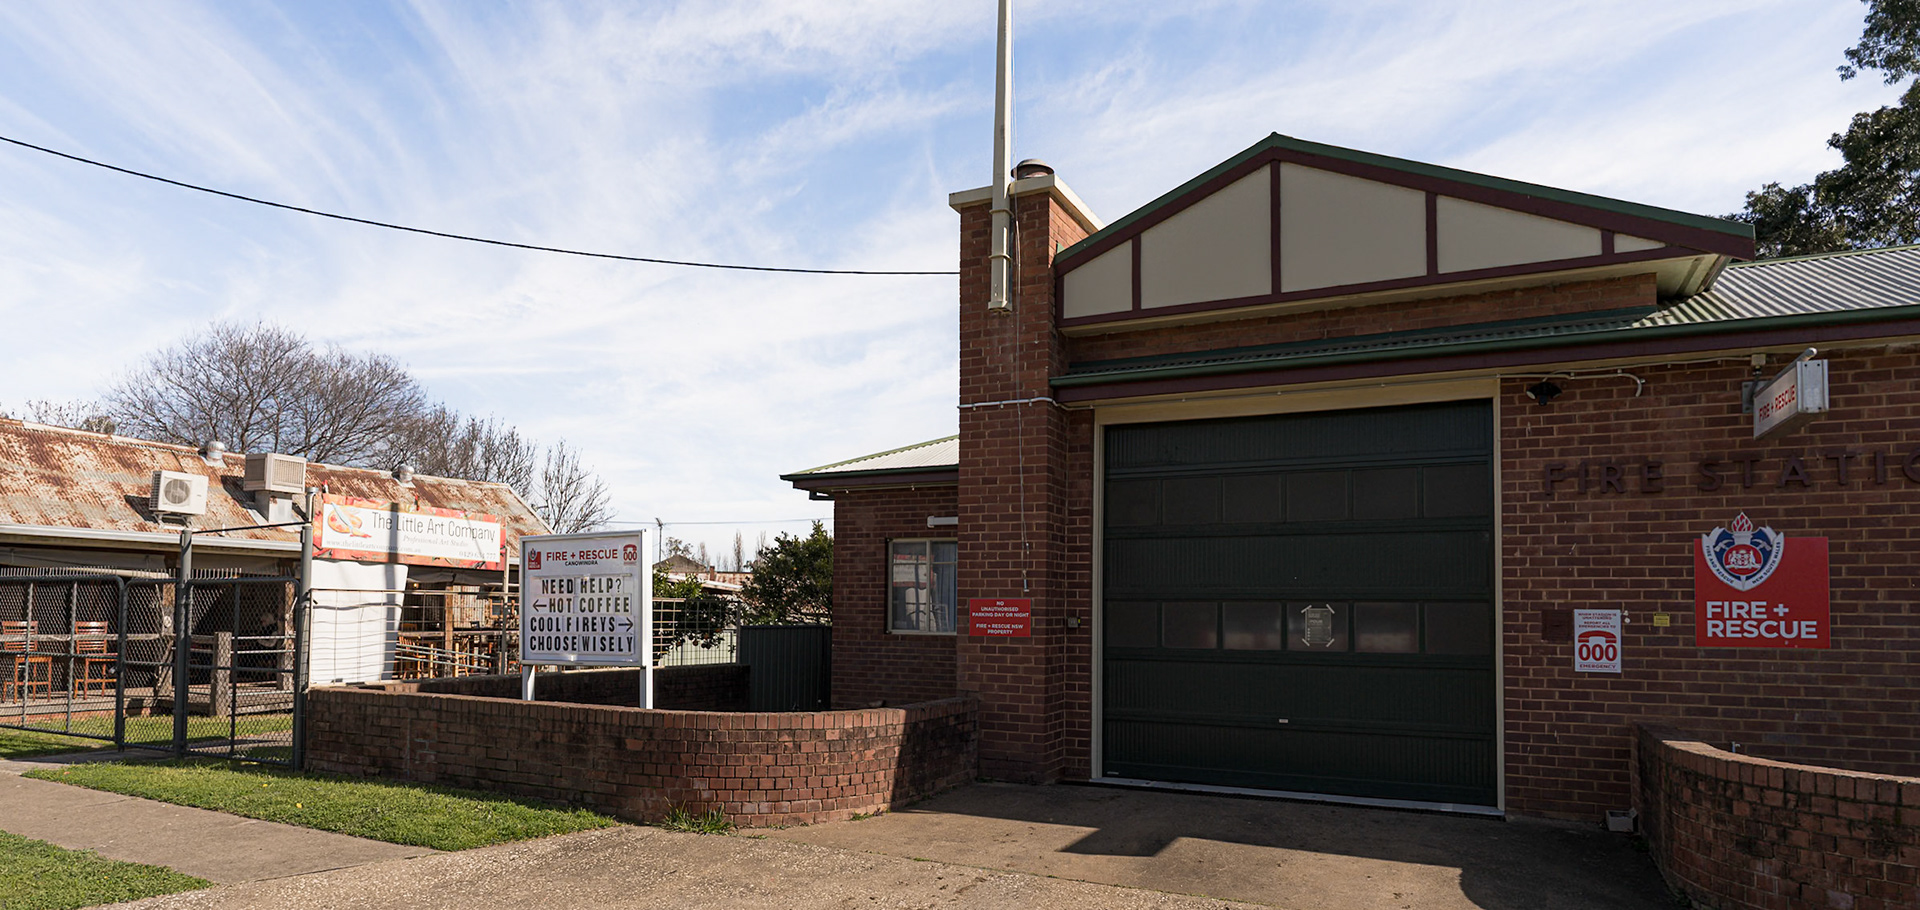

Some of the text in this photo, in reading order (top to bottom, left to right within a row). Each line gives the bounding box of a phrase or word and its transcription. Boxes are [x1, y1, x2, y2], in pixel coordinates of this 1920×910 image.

[1759, 403, 1770, 422] FIRE
[1775, 384, 1795, 412] RESCUE
[1544, 460, 1665, 496] FIRE
[372, 511, 496, 543] The Little Art Company
[403, 534, 469, 548] Professional Art Studio
[546, 551, 568, 562] FIRE
[579, 549, 618, 560] RESCUE
[623, 551, 637, 561] 000
[1763, 560, 1776, 576] SOUTH
[542, 578, 622, 594] NEED HELP?
[549, 597, 629, 613] HOT COFFEE
[1706, 601, 1767, 619] FIRE
[530, 616, 615, 632] COOL FIREYS
[1707, 620, 1818, 639] RESCUE
[530, 635, 633, 652] CHOOSE WISELY
[1578, 643, 1617, 661] 000
